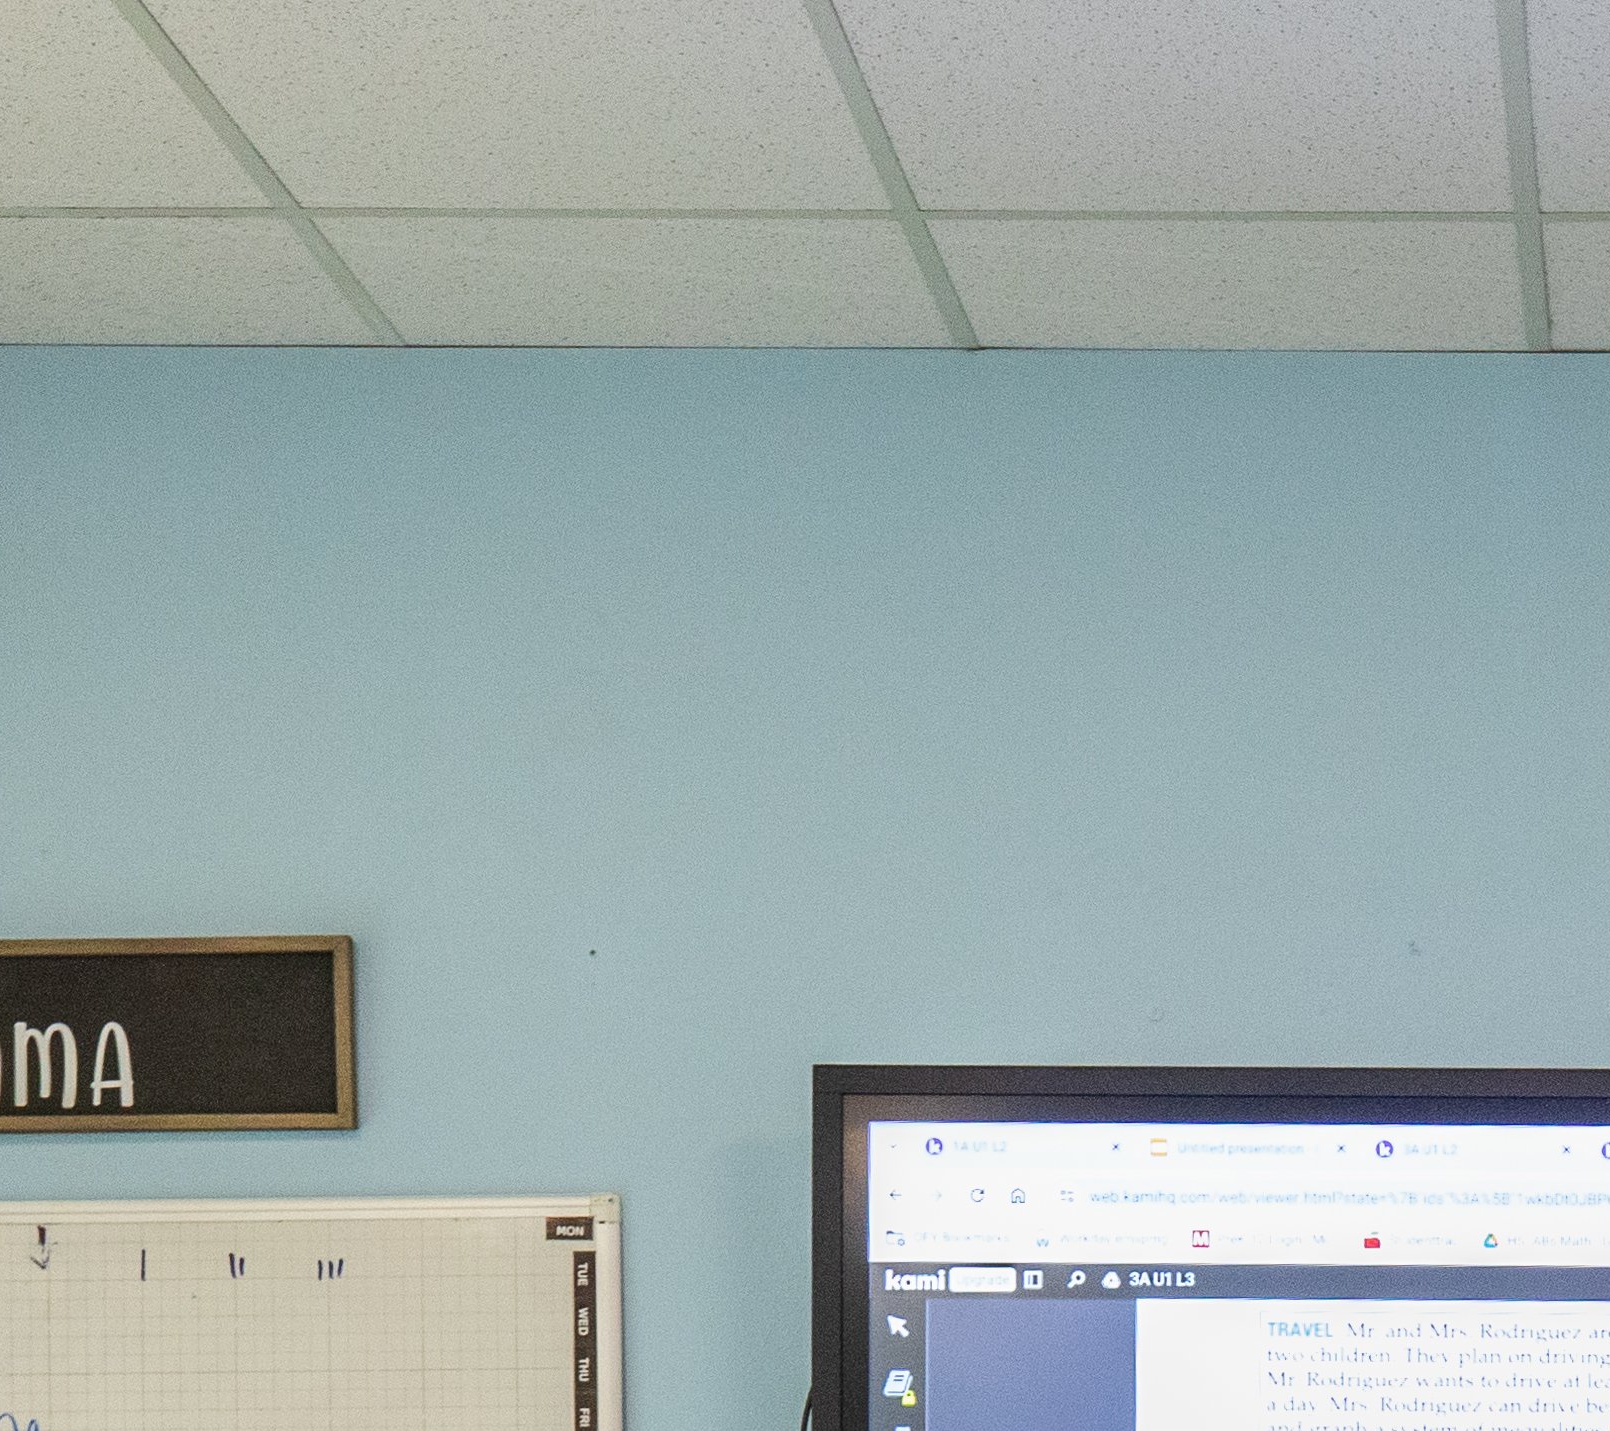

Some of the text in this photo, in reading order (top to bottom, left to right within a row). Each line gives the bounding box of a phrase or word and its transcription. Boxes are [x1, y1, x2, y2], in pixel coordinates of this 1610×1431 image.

[555, 1225, 585, 1237] MON
[577, 1262, 588, 1287] TUE
[884, 1270, 946, 1291] kami
[1129, 1272, 1195, 1287] 3A U1 L3
[578, 1307, 589, 1337] WED
[1267, 1321, 1334, 1338] TRAVEL
[1385, 1324, 1422, 1338] and
[1480, 1323, 1582, 1342] Rodriguez
[578, 1357, 589, 1382] THU
[579, 1407, 590, 1428] FRI
